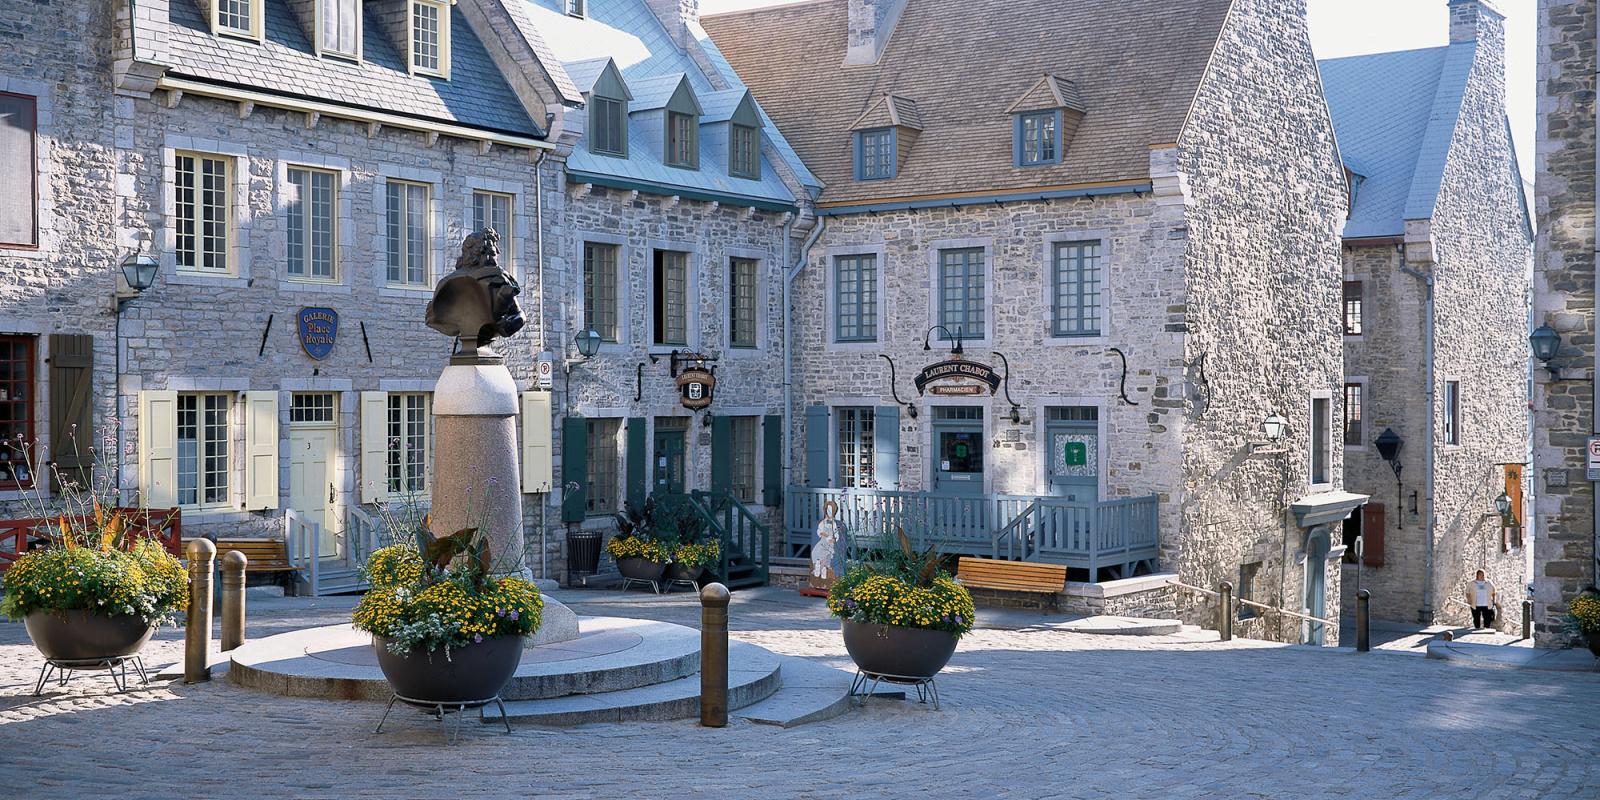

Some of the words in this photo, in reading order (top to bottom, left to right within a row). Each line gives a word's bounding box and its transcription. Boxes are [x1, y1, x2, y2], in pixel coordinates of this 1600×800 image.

[303, 312, 333, 323] GALERIE
[307, 322, 330, 333] Place
[305, 334, 333, 345] Royale
[925, 364, 958, 379] LAURENT
[960, 364, 990, 378] CHABOT
